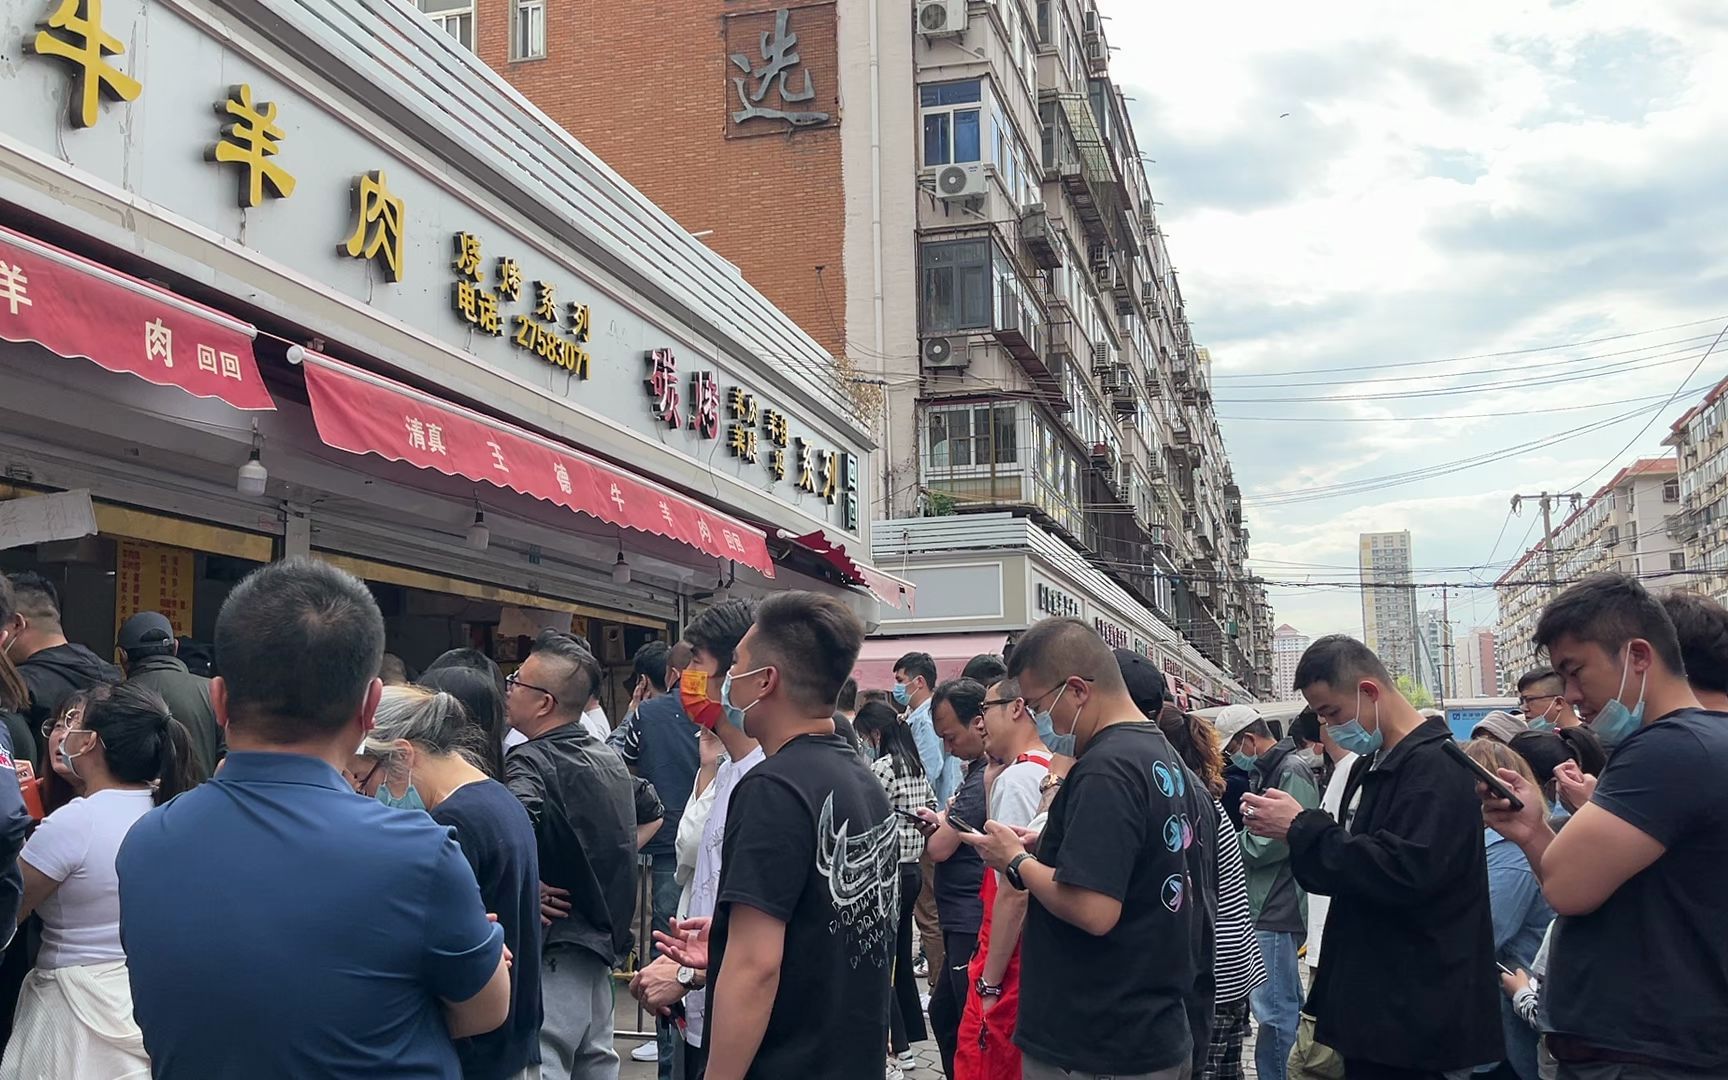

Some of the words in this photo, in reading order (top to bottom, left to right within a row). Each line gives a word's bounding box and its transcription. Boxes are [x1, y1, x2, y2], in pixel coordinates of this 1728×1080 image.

[730, 8, 829, 126] 选
[453, 231, 591, 342] 烧烤系列
[511, 315, 591, 381] 27583071
[644, 348, 719, 439] 碳烤
[405, 415, 446, 456] 清真
[795, 437, 836, 504] 系列
